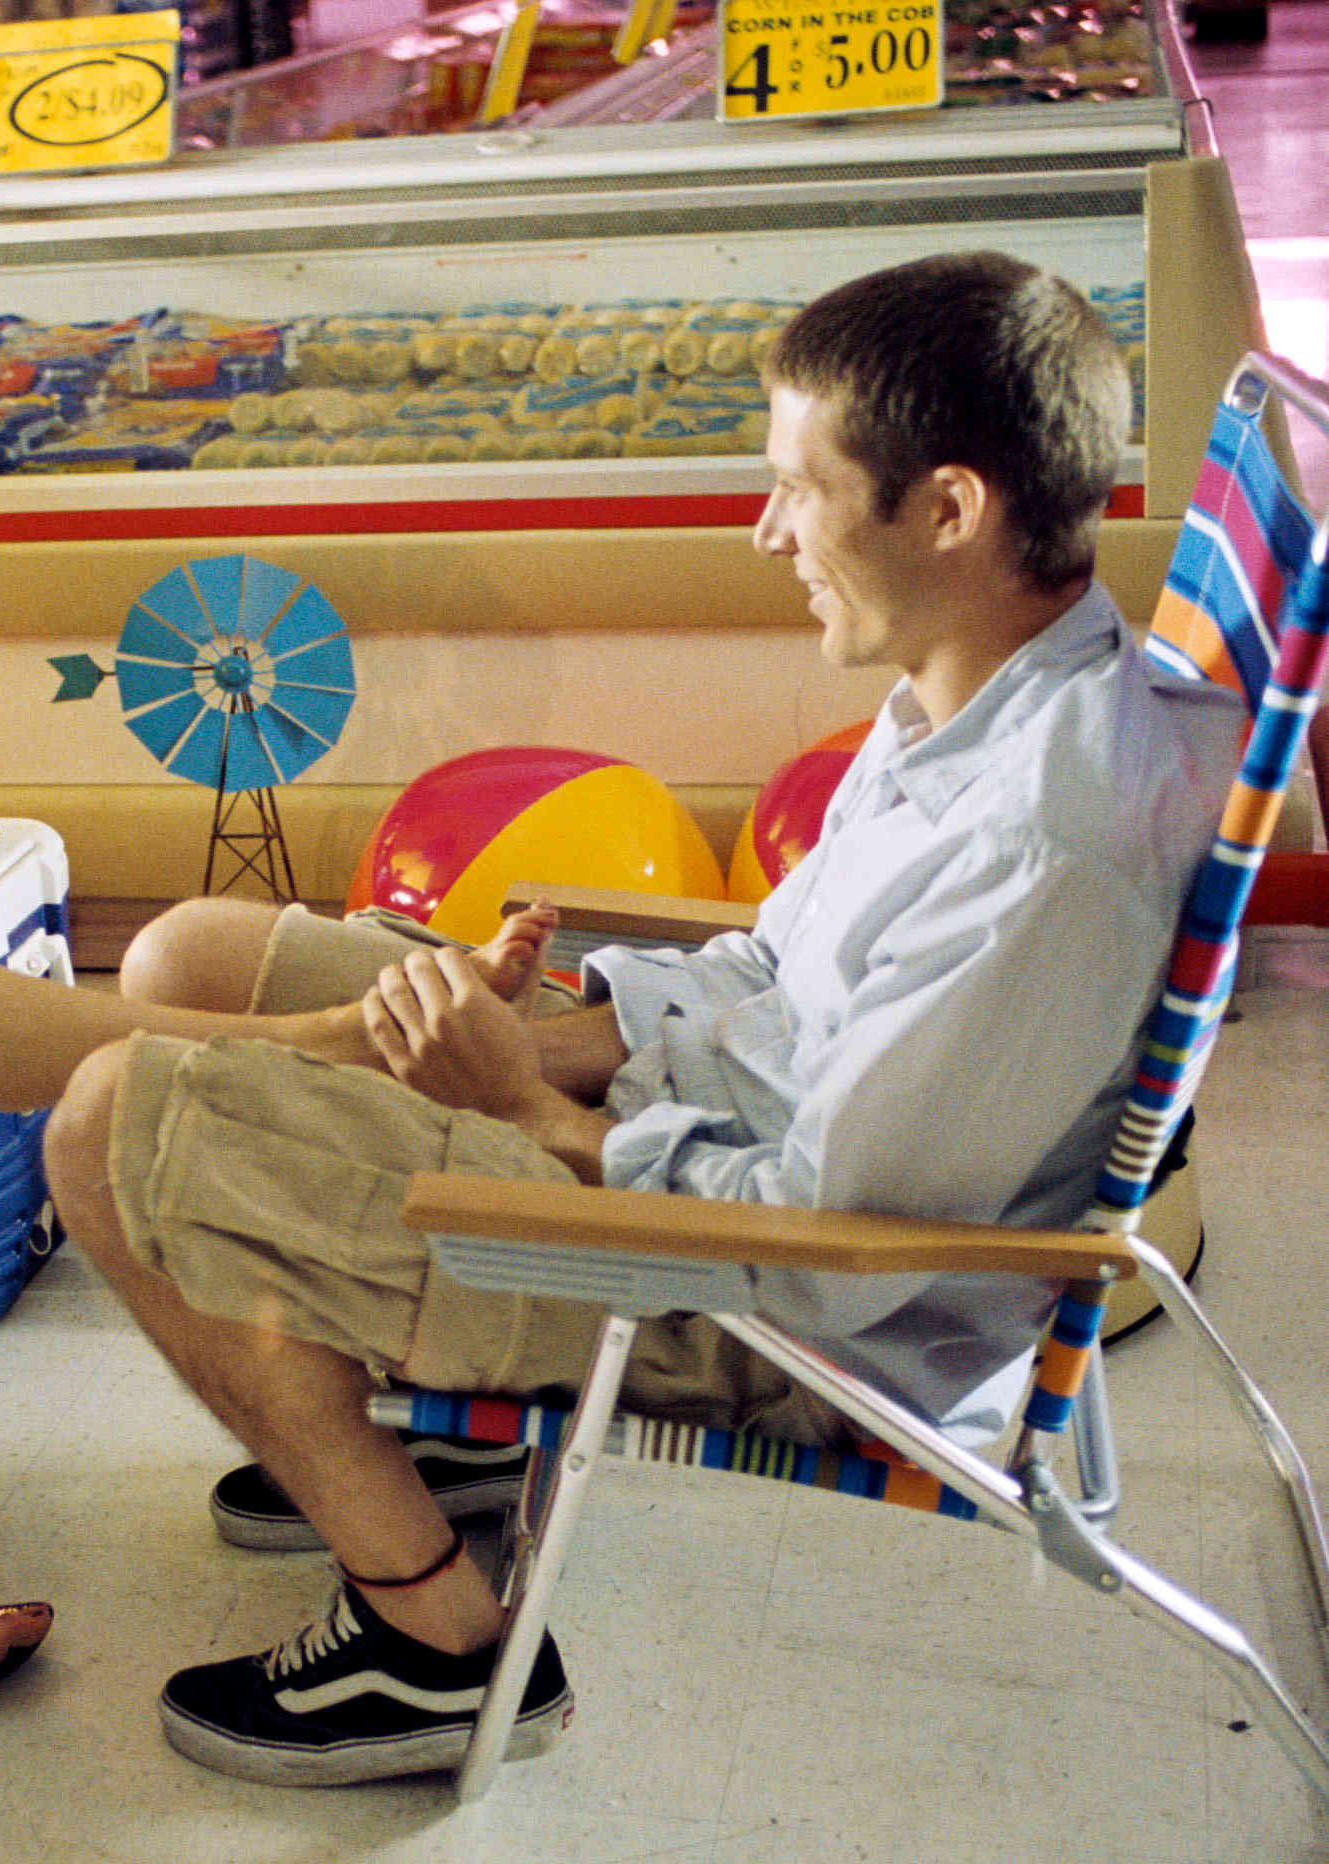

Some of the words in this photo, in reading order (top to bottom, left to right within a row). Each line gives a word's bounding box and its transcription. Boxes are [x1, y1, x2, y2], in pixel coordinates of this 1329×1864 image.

[726, 17, 792, 34] CORN
[800, 14, 823, 28] IN
[833, 9, 877, 26] THE
[886, 5, 934, 22] COB
[725, 44, 778, 113] 4
